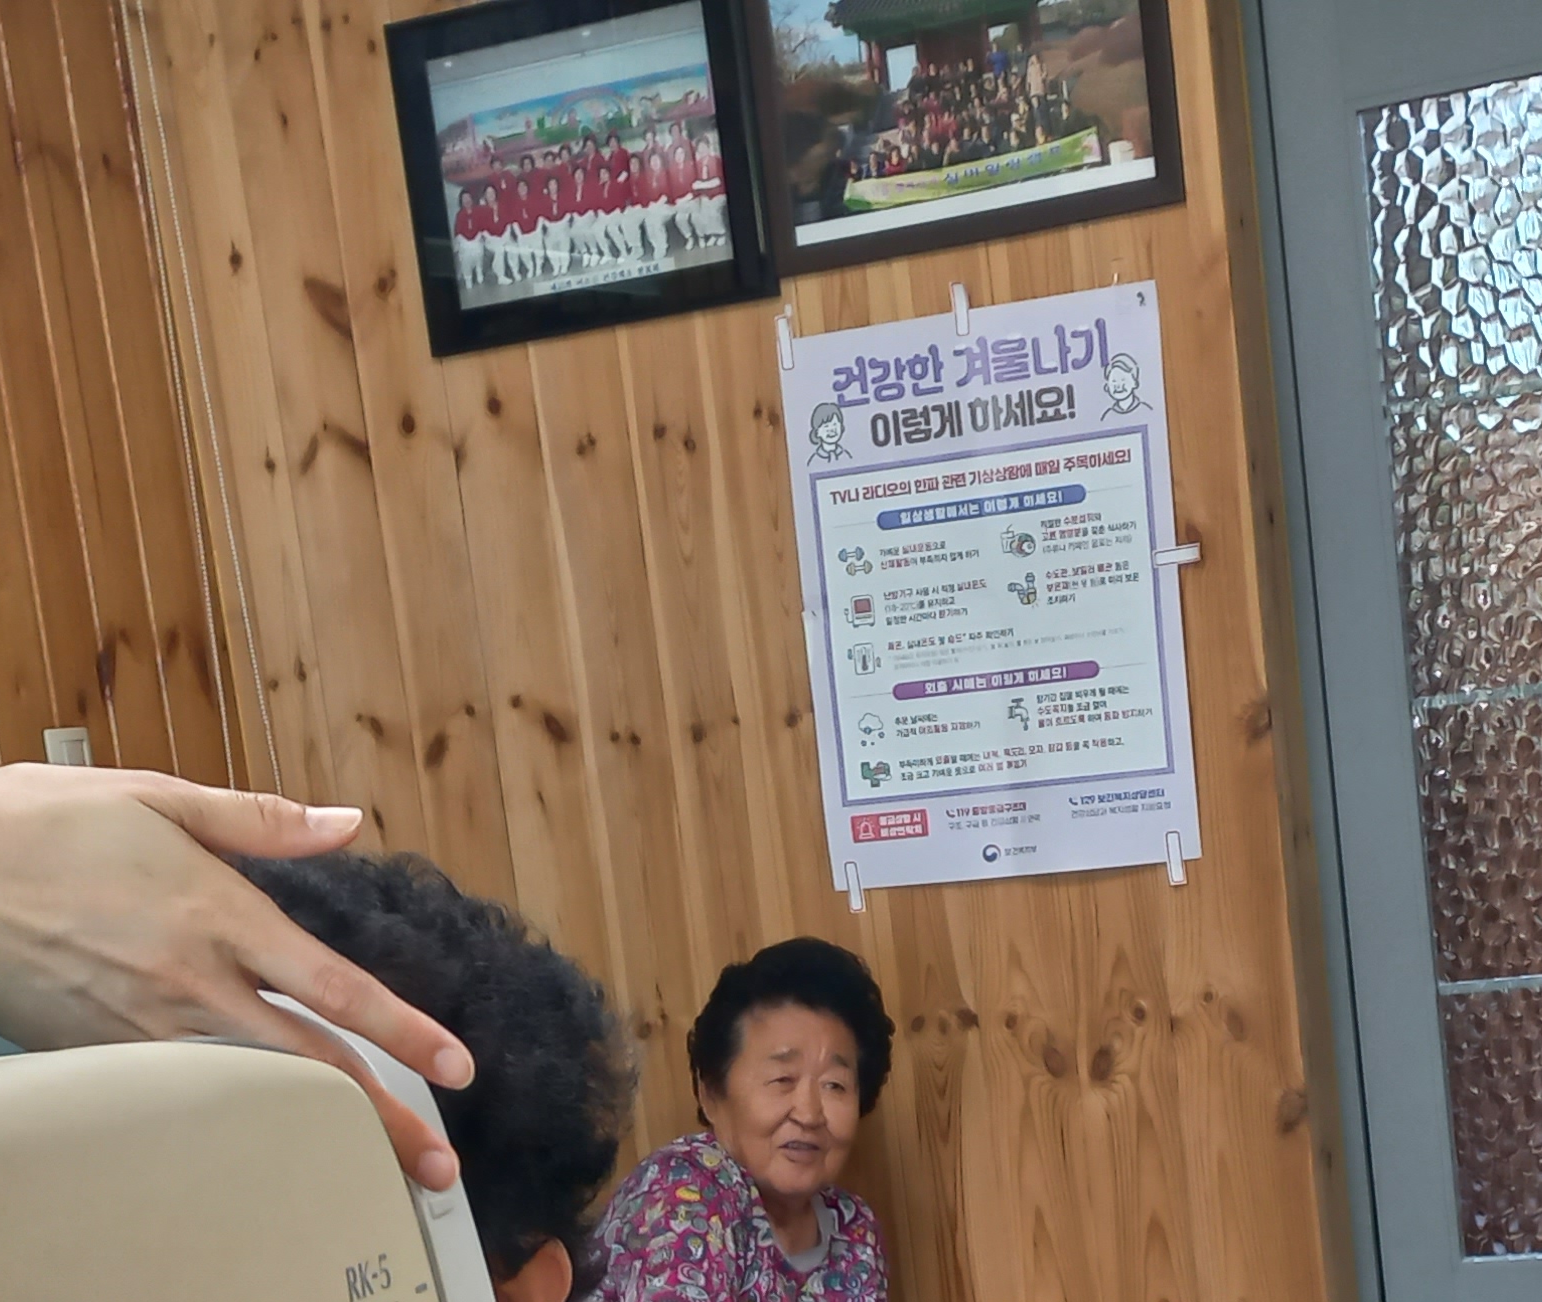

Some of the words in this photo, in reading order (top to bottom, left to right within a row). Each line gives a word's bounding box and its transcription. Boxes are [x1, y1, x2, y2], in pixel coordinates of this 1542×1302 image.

[833, 344, 944, 408] 건강한
[953, 318, 1109, 387] 겨울나기
[870, 400, 963, 447] 이렇게
[970, 384, 1076, 433] 하세요!
[830, 487, 859, 505] TV나
[863, 480, 911, 500] 라디오의
[914, 477, 939, 493] 한파
[942, 472, 967, 489] 관련
[969, 463, 1032, 486] 기상상황에
[1035, 460, 1060, 476] 매일
[1063, 448, 1131, 472] 주목하세요!
[984, 496, 1020, 513] 이렇게
[924, 679, 947, 694] 외출
[952, 675, 987, 691] 시에는
[956, 808, 970, 817] 119
